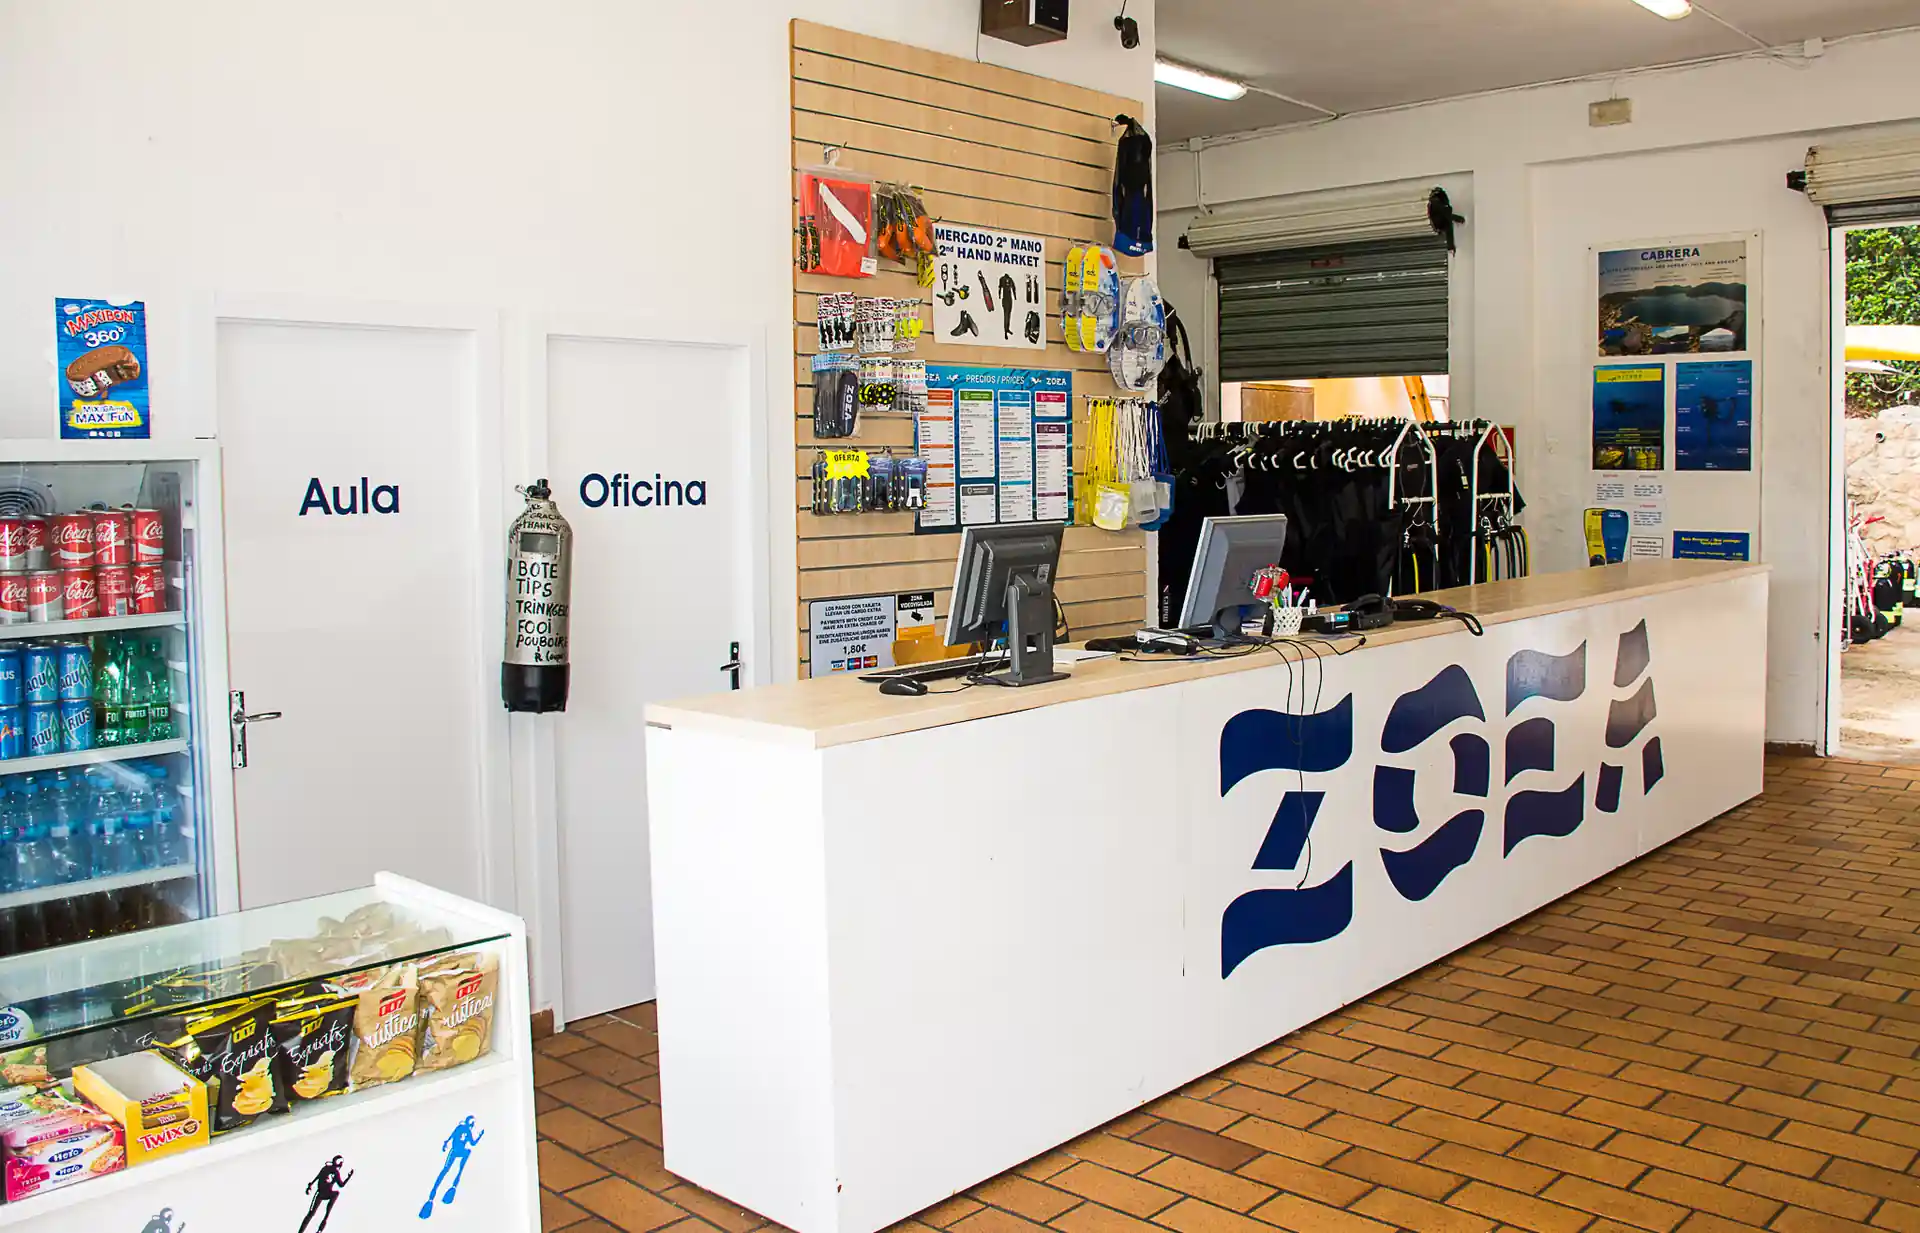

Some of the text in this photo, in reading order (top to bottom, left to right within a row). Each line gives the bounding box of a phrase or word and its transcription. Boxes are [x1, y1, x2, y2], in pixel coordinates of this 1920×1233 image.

[935, 228, 993, 246] MERCADO
[1010, 238, 1042, 253] MANO
[939, 245, 1040, 267] 2nd HAND MARKET
[1641, 247, 1700, 261] CABRERA
[65, 309, 135, 337] MAXIBON
[966, 375, 996, 385] PRECIOS
[1001, 375, 1025, 385] PRICES
[75, 413, 105, 424] MAX
[299, 477, 400, 516] Aula
[580, 473, 707, 508] Oficina
[518, 560, 558, 579] BOTE
[843, 643, 867, 655] 1,80€
[1220, 618, 1664, 980] ZOEA
[137, 1126, 183, 1151] Twix
[54, 1148, 80, 1161] Hero
[60, 1164, 81, 1176] Hero
